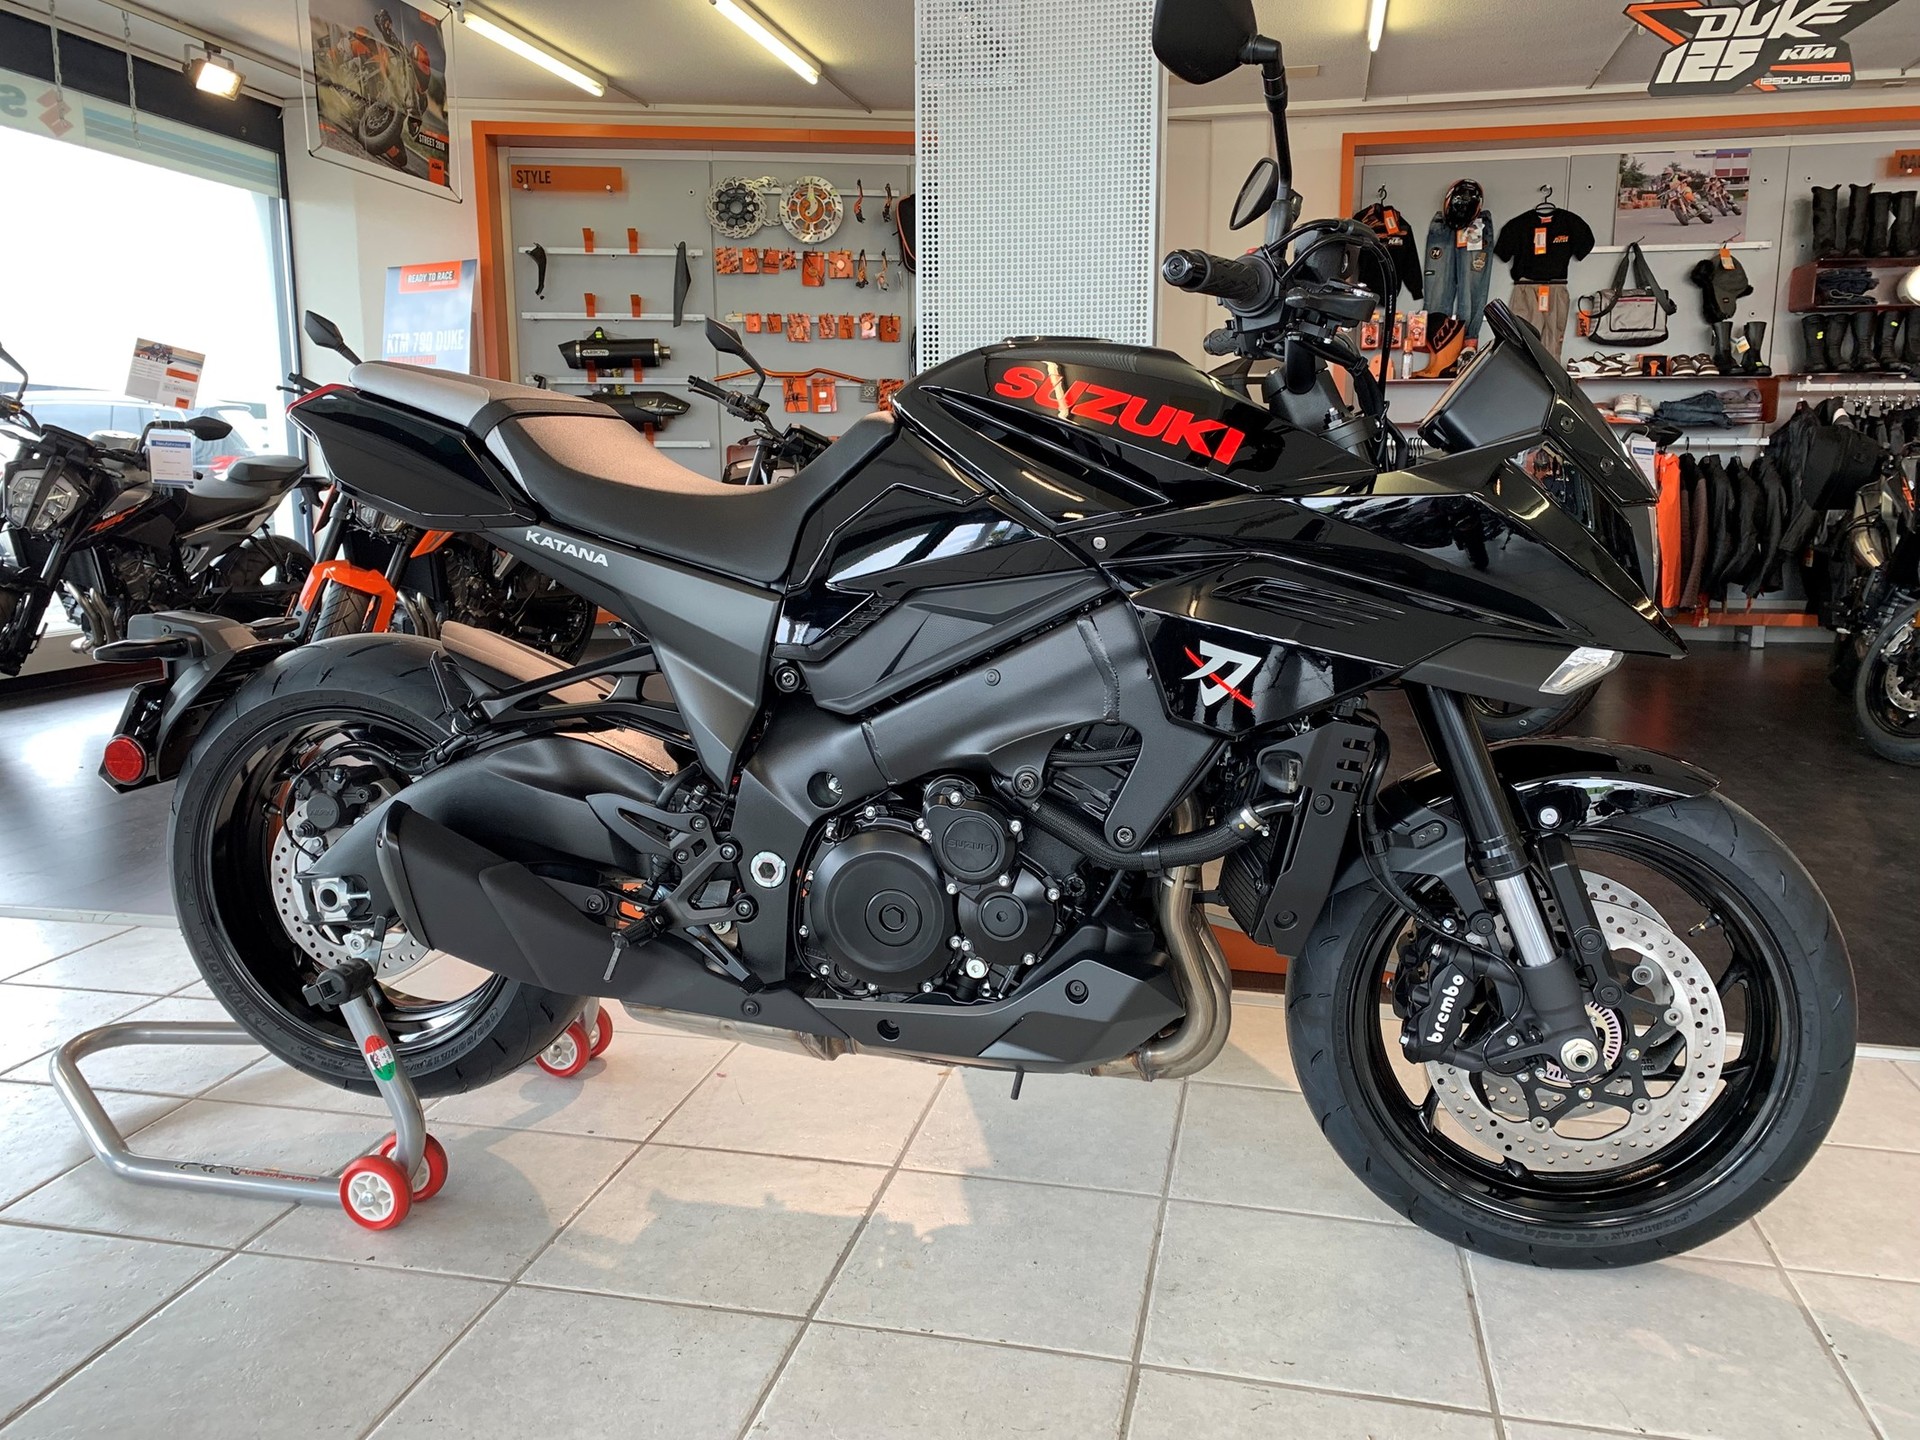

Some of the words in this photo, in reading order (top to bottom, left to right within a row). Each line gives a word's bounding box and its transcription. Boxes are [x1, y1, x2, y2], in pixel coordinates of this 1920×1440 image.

[1683, 0, 1872, 40] DUKE
[1654, 38, 1765, 84] 125
[1777, 43, 1837, 61] KTM
[1760, 74, 1851, 86] 125DUKE.COM
[418, 133, 434, 147] STREET
[516, 169, 552, 184] STYLE
[407, 274, 427, 283] READY
[428, 273, 436, 281] TO
[437, 271, 454, 280] RACE
[386, 332, 410, 354] KTM
[413, 331, 433, 352] 790
[435, 329, 465, 350] DUKE
[995, 366, 1245, 465] SUZUKI
[525, 530, 608, 567] KATANA
[947, 840, 994, 852] SUZUKI
[1426, 974, 1464, 1043] brembo
